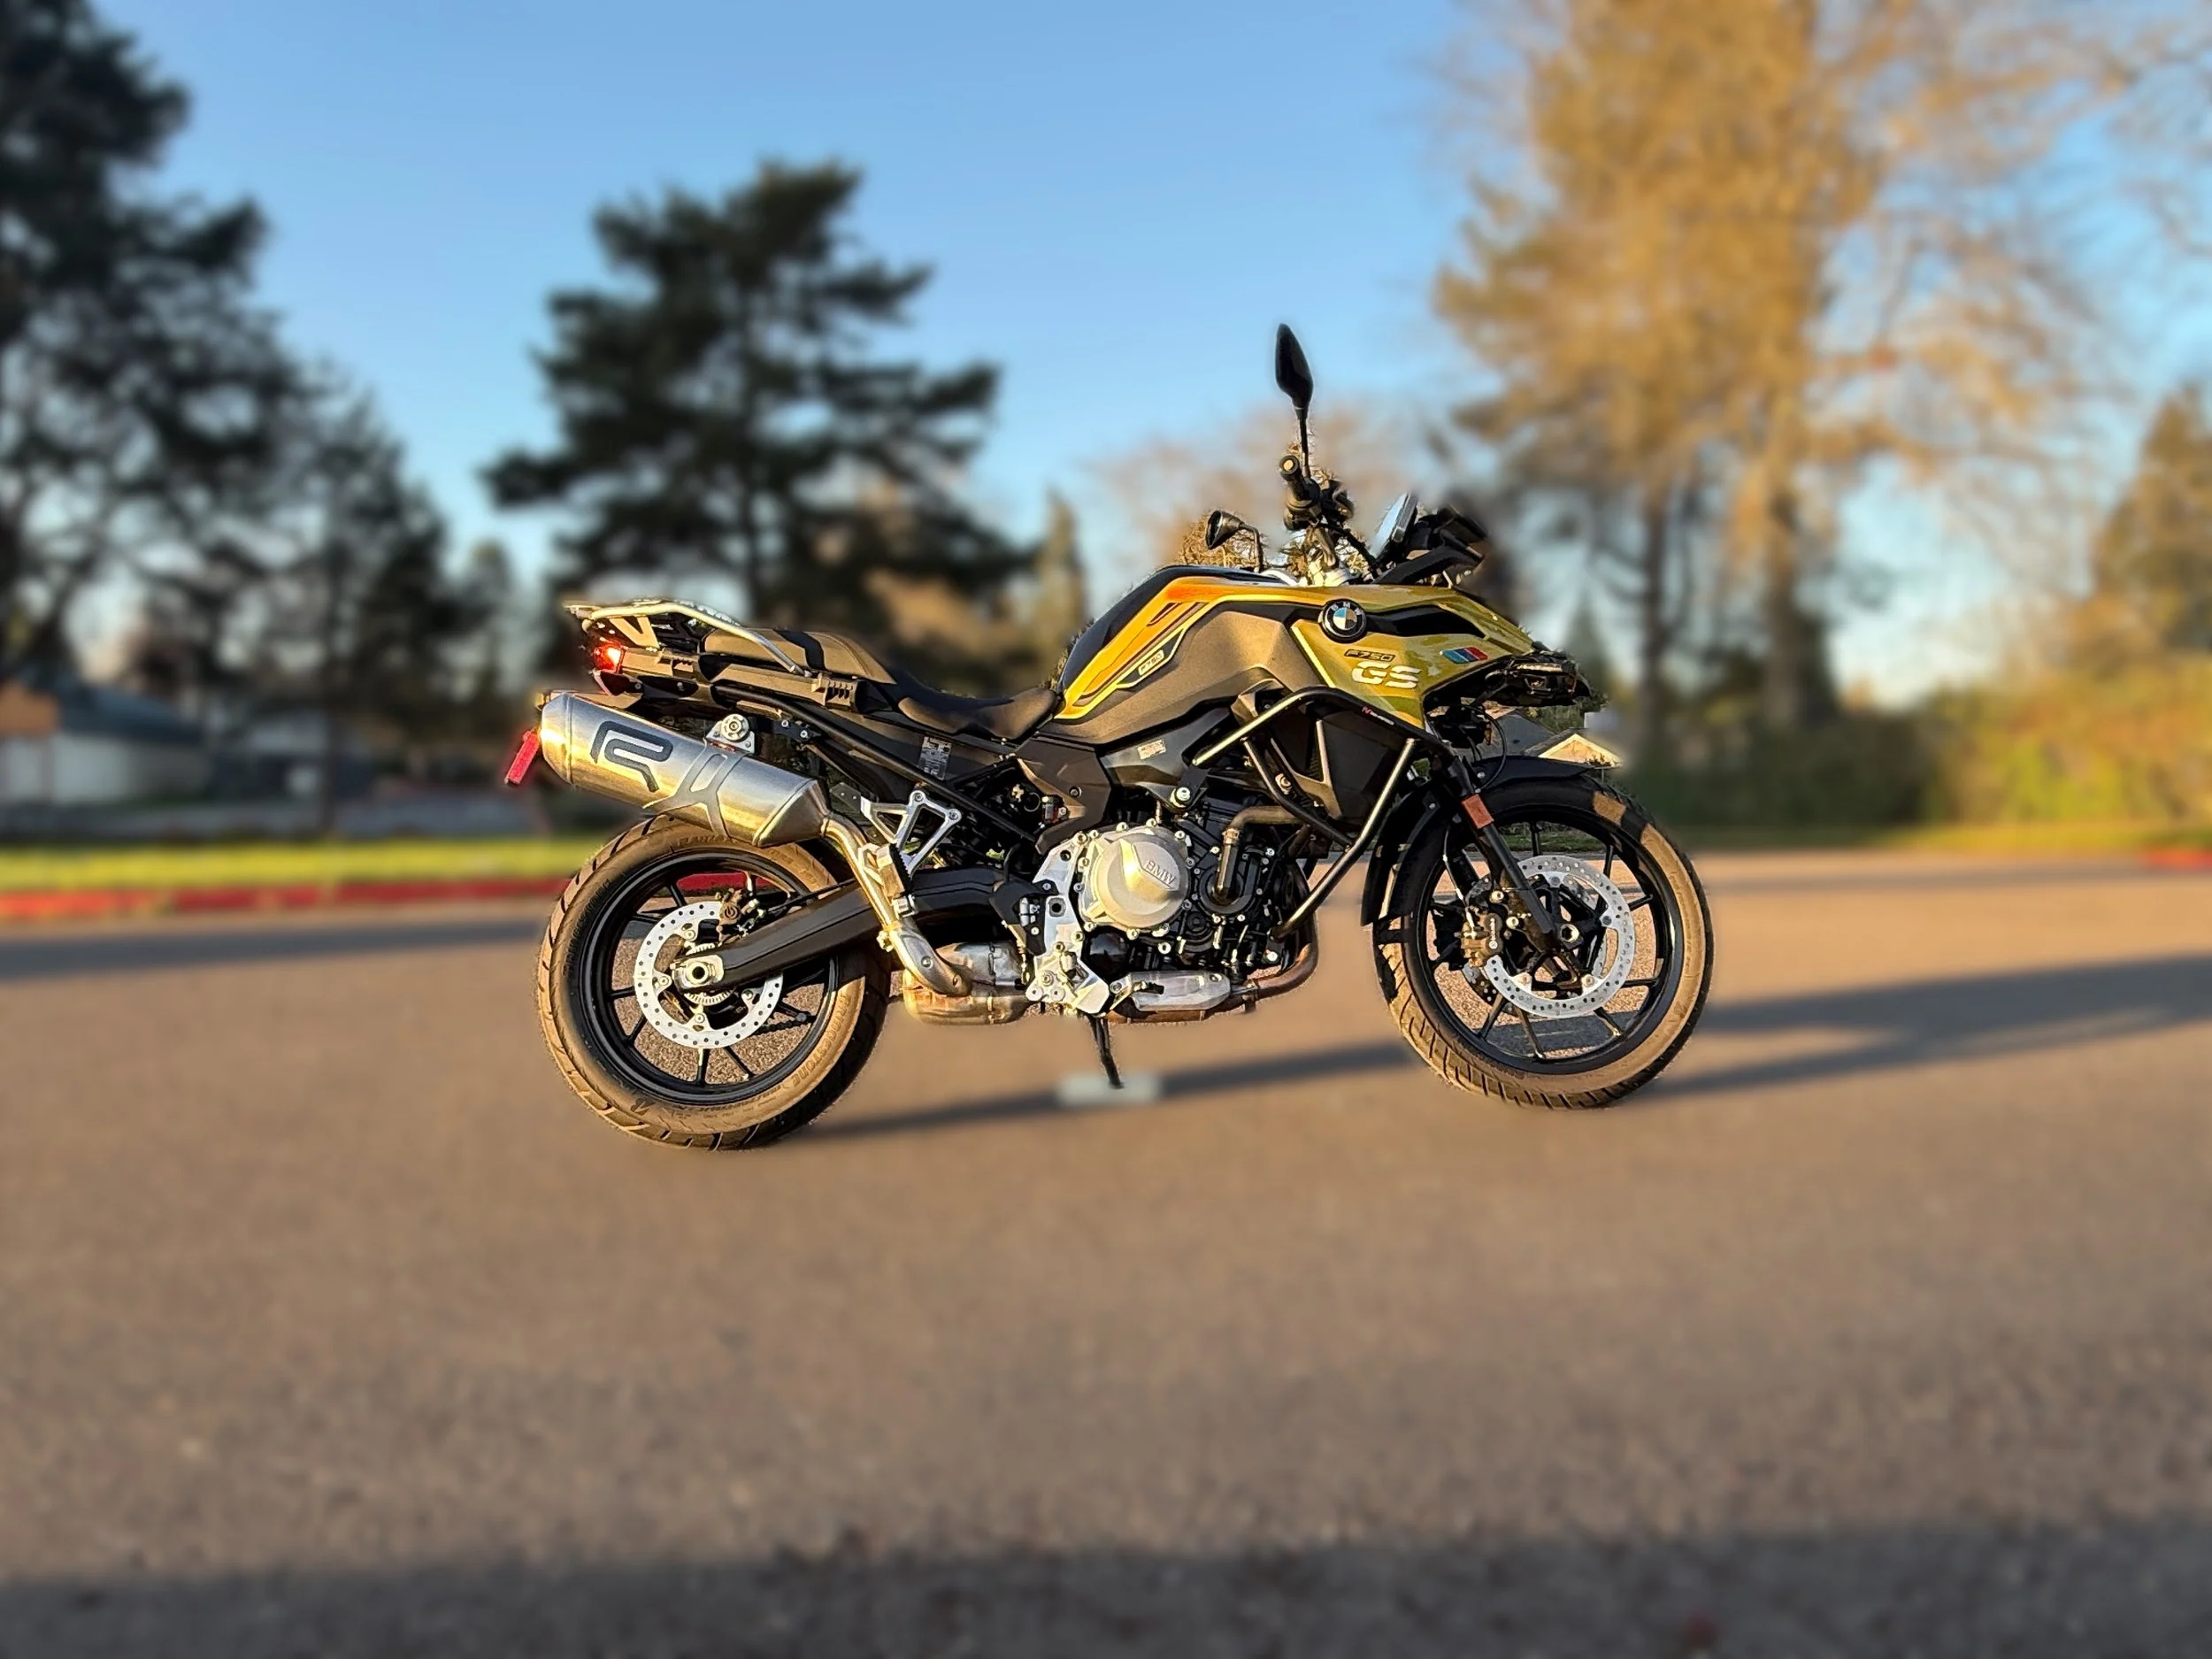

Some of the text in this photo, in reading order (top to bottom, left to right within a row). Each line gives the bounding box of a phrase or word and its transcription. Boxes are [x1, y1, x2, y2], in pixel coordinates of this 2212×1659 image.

[1140, 652, 1164, 672] F750
[1345, 649, 1395, 662] F750
[1352, 660, 1421, 689] GS
[1146, 858, 1177, 885] BMW
